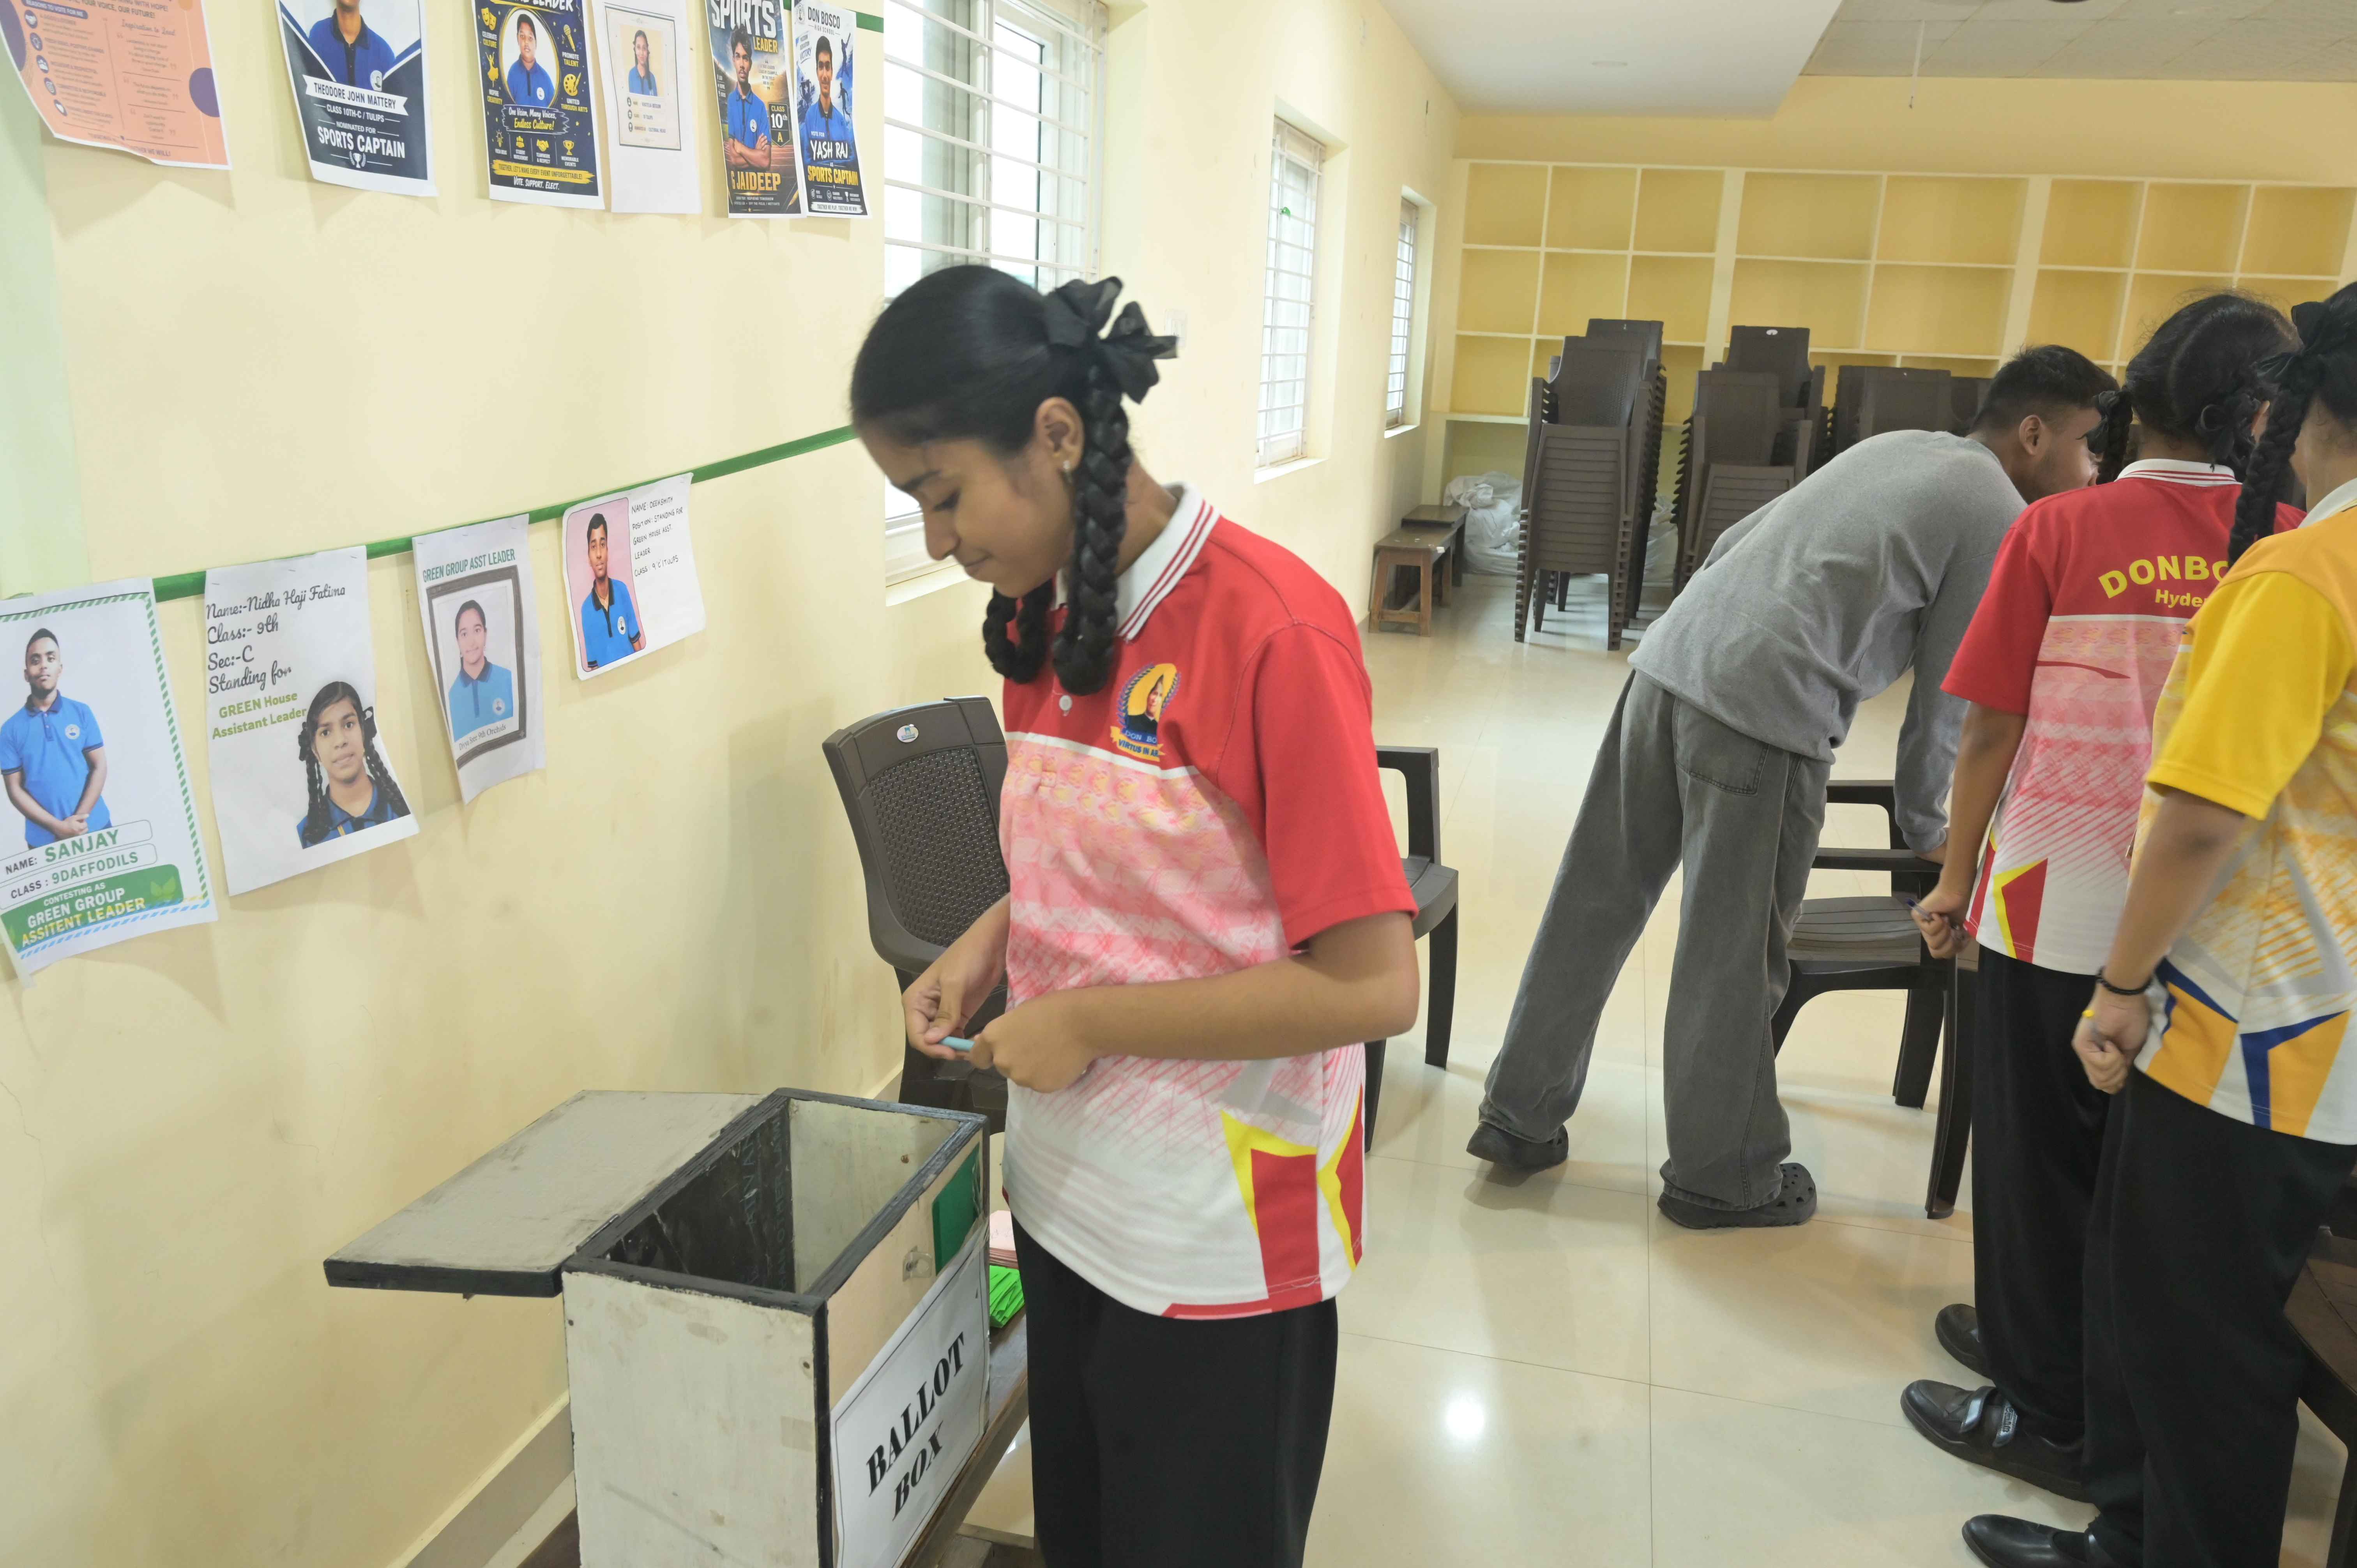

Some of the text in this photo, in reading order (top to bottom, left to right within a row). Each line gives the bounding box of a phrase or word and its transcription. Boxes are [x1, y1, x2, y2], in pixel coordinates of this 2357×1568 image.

[710, 0, 776, 38] SPORTS
[808, 7, 840, 29] DON BOSCO
[753, 36, 778, 53] LEADER
[562, 51, 580, 60] PROMOTE
[564, 58, 578, 67] TALENT
[314, 83, 396, 109] THEODORE JOHN MATTERY
[327, 104, 342, 115] CLASS
[343, 108, 361, 118] 10TH-C
[366, 112, 384, 122] TULIPS
[529, 109, 541, 120] Many
[542, 110, 557, 120] Voices,
[771, 113, 788, 129] 10th
[336, 121, 364, 132] NOMINATED
[514, 118, 555, 130] Endless Culture!
[318, 126, 405, 159] SPORTS CAPTAIN
[777, 132, 784, 142] A
[810, 140, 848, 161] YASH RAJ
[731, 171, 781, 191] G JAIDEEP
[807, 165, 859, 186] SPORTS CAPTAIN
[654, 509, 675, 522] STANDING
[633, 534, 647, 545] GREEN
[649, 529, 661, 538] HOUSE
[635, 547, 651, 560] LEADER
[423, 548, 515, 583] GREEN GROUP ASST LEADER
[283, 589, 307, 610] Haji
[309, 584, 345, 600] Fatima
[257, 612, 279, 635] 9th
[209, 660, 292, 694] Standing for
[219, 693, 298, 719] GREEN House
[212, 708, 307, 740] Assistant Leader
[487, 724, 506, 736] Orchids
[1125, 730, 1142, 740] DON
[1119, 739, 1142, 753] VIRTUS
[6, 829, 118, 874] NAME: SANJAY
[51, 851, 138, 884] 9DAFFODILS
[43, 882, 106, 906] CONTESTING AS
[27, 888, 125, 929] GREEN GROUP
[22, 897, 146, 948] ASSITENT LEADER
[866, 1332, 964, 1496] BALLOT
[892, 1420, 944, 1520] BOX
